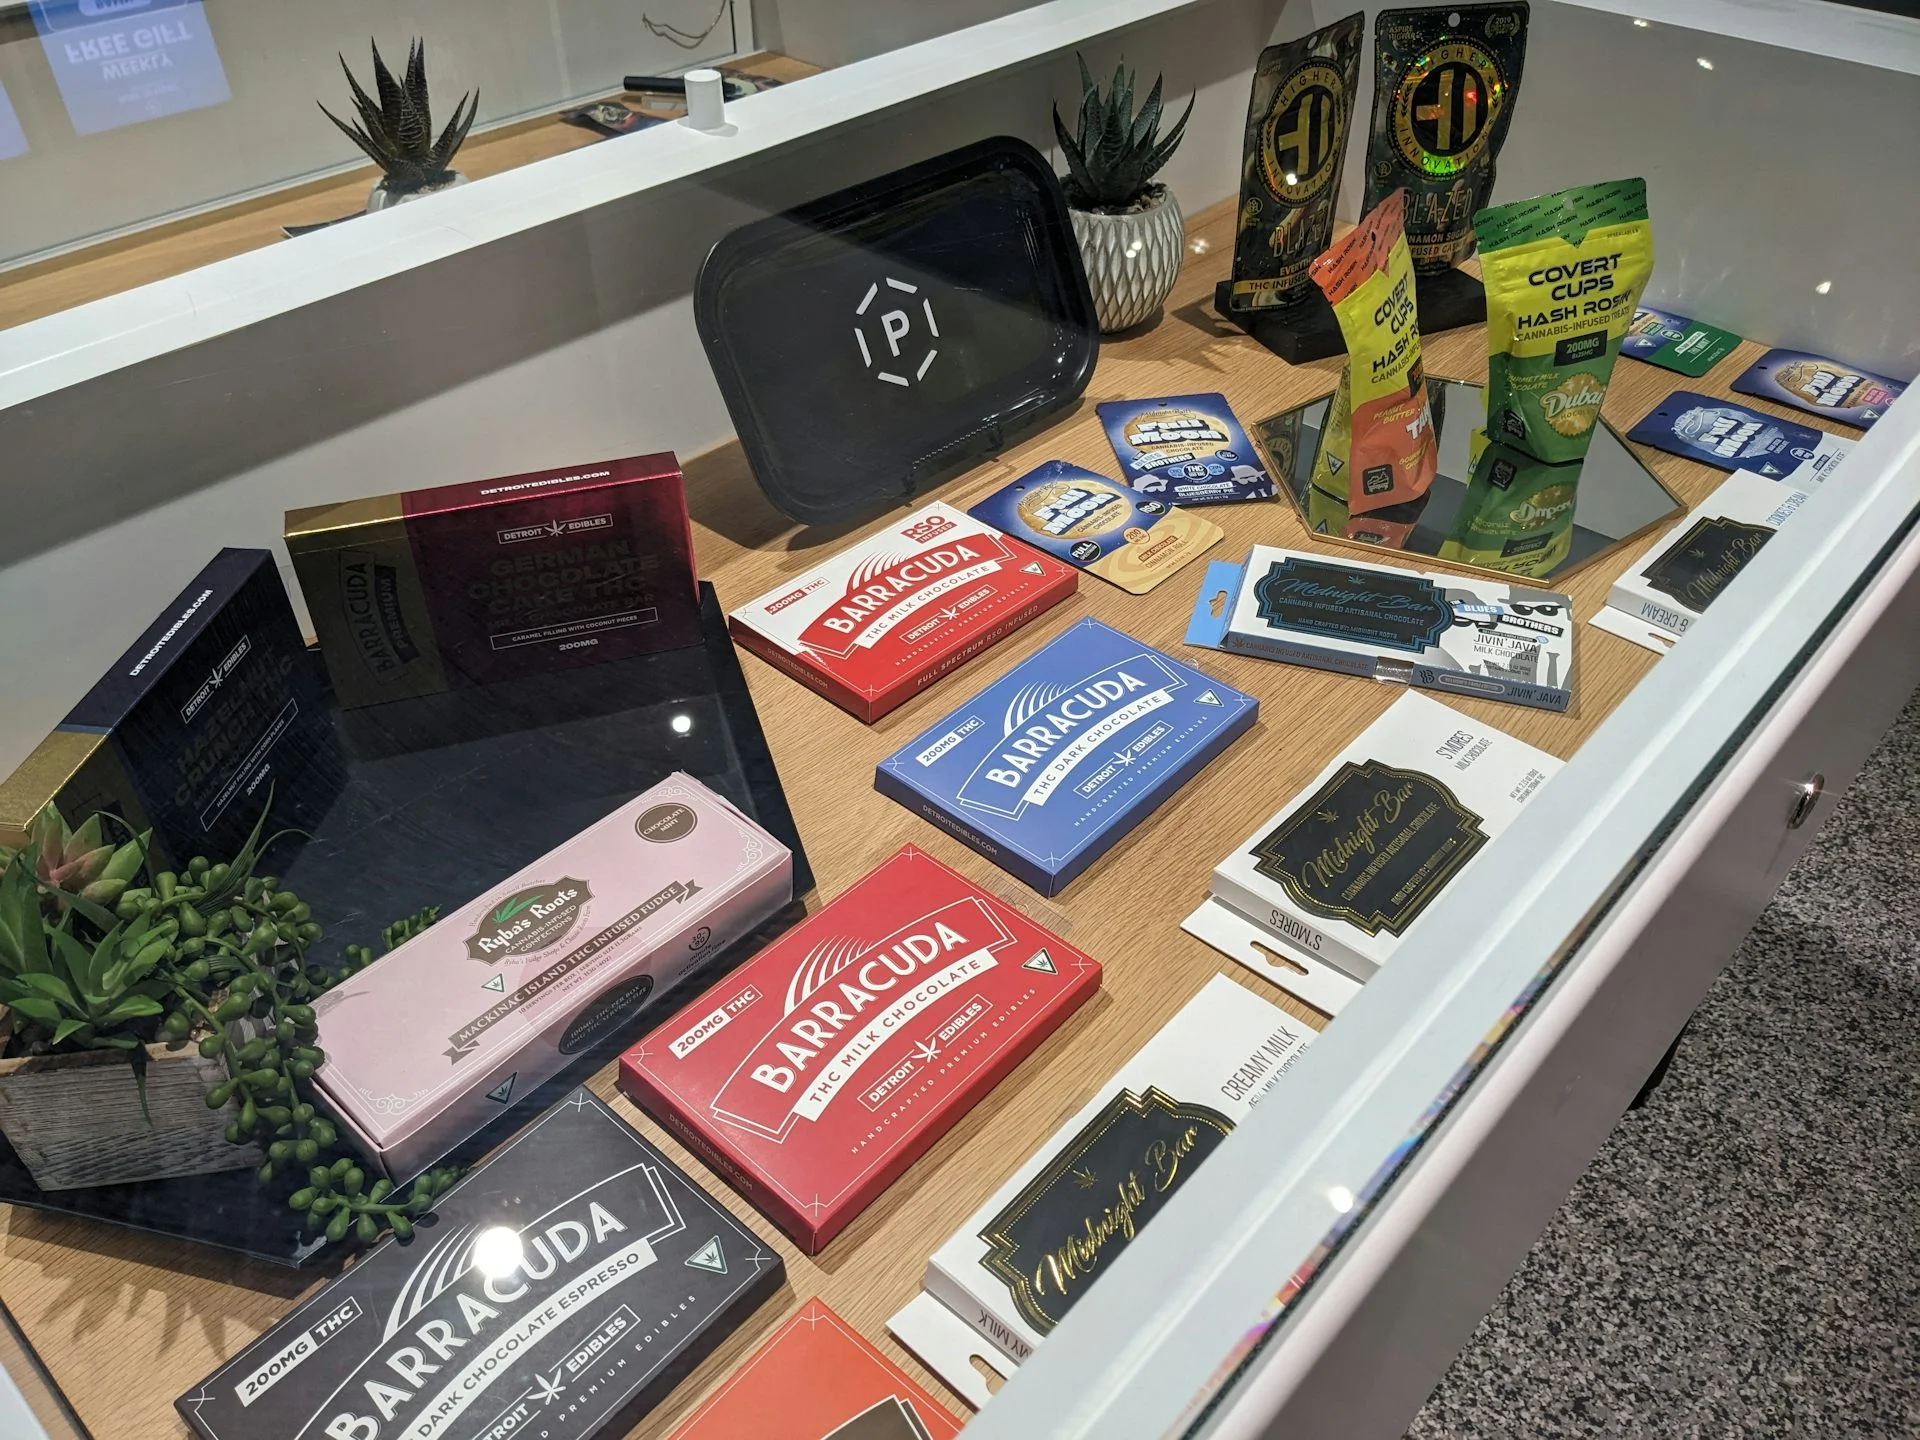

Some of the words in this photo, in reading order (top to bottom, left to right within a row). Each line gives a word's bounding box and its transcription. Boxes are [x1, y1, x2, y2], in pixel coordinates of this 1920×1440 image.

[1281, 71, 1338, 107] HIGHER
[1249, 282, 1269, 290] THC
[1528, 253, 1623, 287] COVERT
[1551, 275, 1614, 301] CUPS
[1374, 271, 1408, 327] COVERT
[1391, 298, 1414, 334] CUPS
[1518, 305, 1577, 330] HASH
[881, 309, 910, 358] P
[1516, 314, 1610, 342] CANNABIS-INFUSED
[1566, 337, 1600, 354] 200MG
[1372, 335, 1409, 373] HASH
[1128, 429, 1223, 446] Moon
[1137, 419, 1203, 433] Full
[480, 469, 611, 496] DETROITEDIBLES.COM
[1144, 453, 1193, 470] BROTHERS
[1033, 488, 1088, 521] Full
[1043, 493, 1114, 535] Moon
[1141, 501, 1162, 514] RSO
[503, 526, 543, 541] DETROIT
[568, 516, 607, 533] EDIBLES
[902, 515, 946, 539] RSO
[919, 522, 956, 544] INFUSED
[490, 539, 631, 575] GERMAN
[1071, 541, 1093, 559] FULL
[1686, 544, 1742, 602] Midnight
[1732, 530, 1763, 558] Bar
[468, 553, 661, 601] CHOCOLATE
[768, 589, 804, 614] 200MG
[804, 577, 826, 593] THC
[822, 544, 980, 634] BARRACUDA
[1274, 577, 1376, 604] Midnight
[1376, 594, 1435, 613] Bar
[344, 561, 394, 675] BARRACUDA
[865, 618, 889, 641] THC
[886, 599, 915, 623] MILK
[917, 564, 991, 602] CHOCOLATE
[906, 616, 942, 640] DETROIT
[957, 587, 990, 610] EDIBLES
[1279, 597, 1313, 608] CANNABIS
[1314, 602, 1344, 614] INFUSED
[1344, 606, 1383, 620] ARTISANAL
[1384, 612, 1425, 626] CHOCOLATE
[1464, 604, 1498, 613] BLUES
[1641, 602, 1679, 628] CREAM
[129, 588, 214, 677] DETROITEDIBLES.COM
[511, 631, 544, 643] CARAMEL
[544, 627, 567, 638] FILLING
[567, 624, 585, 634] WITH
[585, 619, 616, 631] COCONUT
[616, 614, 638, 625] PIECES
[558, 637, 599, 653] 200MG
[894, 626, 956, 667] HANDCRAFTED
[957, 603, 994, 629] PREMIUM
[915, 668, 939, 687] FULL
[940, 639, 984, 672] SPECTRUM
[985, 626, 1003, 642] RSO
[1004, 604, 1039, 629] INFUSED
[1502, 614, 1560, 635] BROTHERS
[766, 647, 829, 689] DETROITEDIBLES.COM
[1473, 645, 1493, 655] MILK
[1494, 649, 1539, 663] CHOCOLATE
[1507, 640, 1538, 654] JAVA
[185, 685, 212, 717] DETROIT
[222, 641, 248, 673] EDIBLES
[1536, 690, 1562, 705] JAVA
[921, 733, 957, 763] 200MG
[957, 718, 980, 737] THC
[984, 671, 1147, 789] BARRACUDA
[1033, 769, 1057, 797] THC
[1054, 742, 1087, 773] DARK
[1086, 694, 1162, 745] CHOCOLATE
[1435, 730, 1474, 760] S'MORES
[245, 762, 271, 797] 200MG
[1073, 776, 1134, 827] HANDCRAFTED
[1136, 744, 1172, 776] PREMIUM
[1174, 714, 1209, 744] EDIBLES
[1080, 763, 1117, 795] DETROIT
[1130, 724, 1167, 753] EDIBLES
[643, 807, 685, 835] CHOCOLATE
[659, 818, 680, 832] MINT
[921, 804, 999, 857] DETROITEDIBLES.COM
[1302, 808, 1381, 888] Midnight
[1373, 781, 1414, 824] Bar
[1341, 870, 1372, 901] CANNABIS
[1365, 851, 1392, 877] INFUSED
[1385, 829, 1416, 856] ARTISANAL
[1407, 801, 1441, 832] CHOCOLATE
[477, 918, 532, 953] Ryba's
[528, 888, 579, 919] Roots
[505, 904, 577, 954] CANNABIS-INFUSED
[520, 915, 573, 953] CONFECTIONS
[1269, 909, 1323, 951] S'MORES
[458, 994, 526, 1042] MACKINAC
[524, 963, 568, 997] ISLAND
[565, 944, 594, 967] THC
[591, 912, 641, 948] INFUSED
[639, 886, 678, 916] FUDGE
[675, 1012, 725, 1055] 200MG
[727, 988, 757, 1014] THC
[749, 921, 968, 1093] BARRACUDA
[808, 1069, 841, 1104] THC
[840, 1029, 881, 1068] MILK
[879, 958, 982, 1029] CHOCOLATE
[868, 1058, 917, 1104] DETROIT
[937, 1000, 985, 1042] EDIBLES
[850, 1078, 935, 1156] HANDCRAFTED
[938, 1030, 990, 1075] PREMIUM
[992, 986, 1037, 1028] EDIBLES
[1220, 1050, 1273, 1101] CREAMY
[1260, 1025, 1300, 1058] MILK
[667, 1113, 754, 1191] DETROITEDIBLES.COM
[1032, 1170, 1148, 1297] Midnight
[1145, 1123, 1200, 1192] Bar
[322, 1201, 628, 1440] BARRACUDA
[978, 1310, 1010, 1341] MILK
[244, 1340, 310, 1395] 200MG
[314, 1302, 355, 1341] THC
[417, 1389, 465, 1438] DARK
[462, 1307, 559, 1391] CHOCOLATE
[557, 1250, 641, 1318] ESPRESSO
[558, 1355, 629, 1423] PREMIUM
[634, 1293, 698, 1353] EDIBLES
[564, 1314, 628, 1375] EDIBLES
